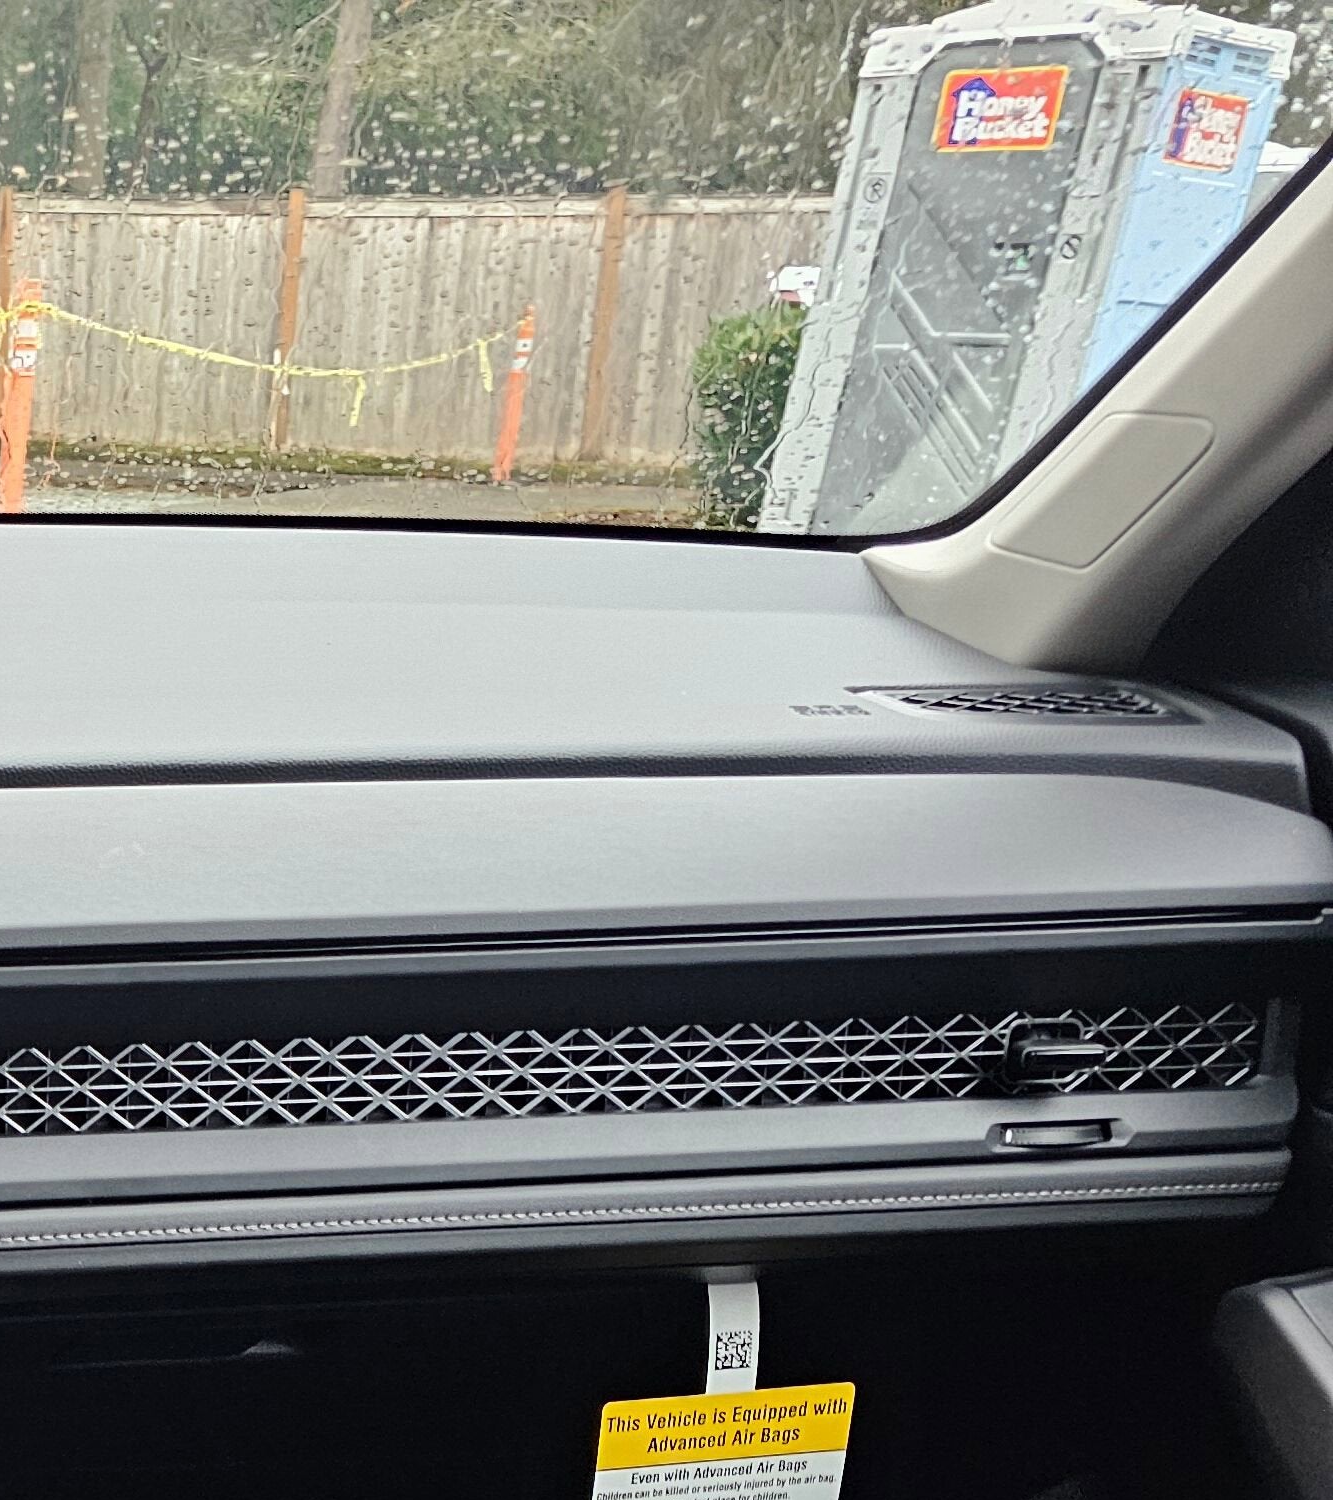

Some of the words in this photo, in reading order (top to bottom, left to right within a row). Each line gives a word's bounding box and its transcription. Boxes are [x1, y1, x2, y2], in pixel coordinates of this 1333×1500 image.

[956, 88, 1049, 121] Honey
[951, 112, 1051, 142] Bucket
[606, 1415, 641, 1433] This
[647, 1410, 707, 1430] Vehicle
[712, 1407, 727, 1425] is
[732, 1401, 808, 1425] Equipped
[813, 1397, 848, 1416] with
[647, 1431, 727, 1453] Advanced
[731, 1428, 757, 1446] Air
[760, 1427, 801, 1445] Bags
[630, 1472, 660, 1485] Even
[664, 1468, 690, 1481] with
[693, 1462, 753, 1480] Advanced
[756, 1460, 775, 1475] Air
[778, 1459, 808, 1474] Bags
[634, 1490, 651, 1499] can
[652, 1488, 663, 1498] be
[665, 1485, 690, 1496] killed
[691, 1485, 700, 1493] or
[702, 1481, 742, 1493] seriously
[743, 1478, 774, 1490] injured
[776, 1477, 787, 1488] by
[788, 1476, 802, 1486] the
[804, 1475, 816, 1484] air
